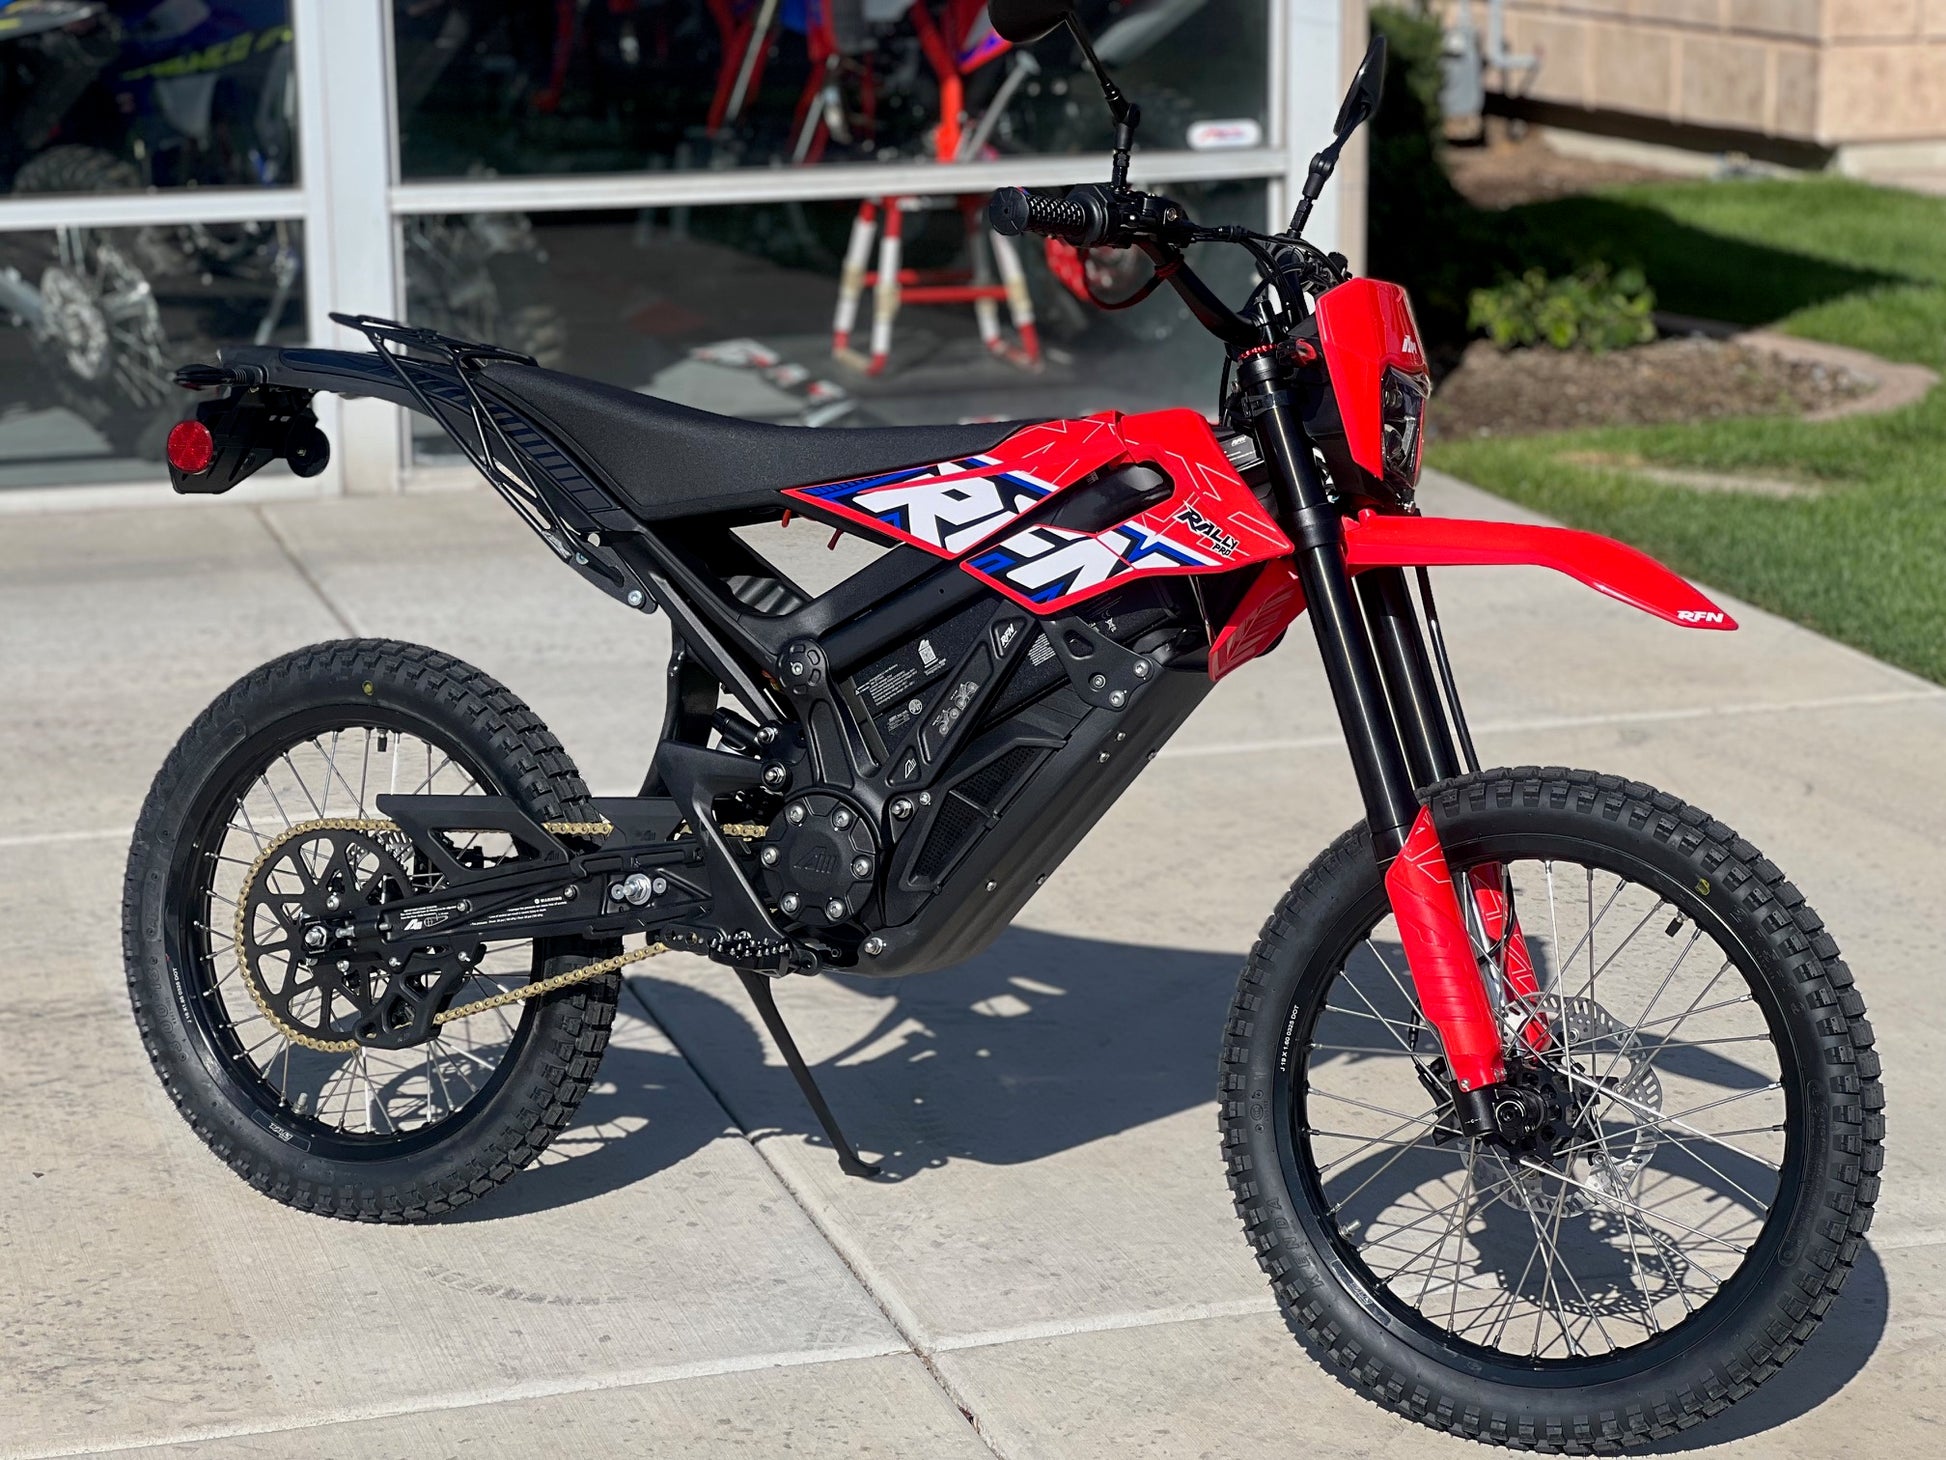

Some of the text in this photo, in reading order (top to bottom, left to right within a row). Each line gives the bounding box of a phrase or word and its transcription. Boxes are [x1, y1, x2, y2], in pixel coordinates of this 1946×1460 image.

[1176, 505, 1239, 550] RALLY
[1211, 542, 1232, 557] PRO
[1677, 610, 1724, 624] RFN
[1000, 623, 1016, 647] RFN
[1290, 1004, 1299, 1020] DOT
[1266, 1197, 1326, 1289] KENDA
